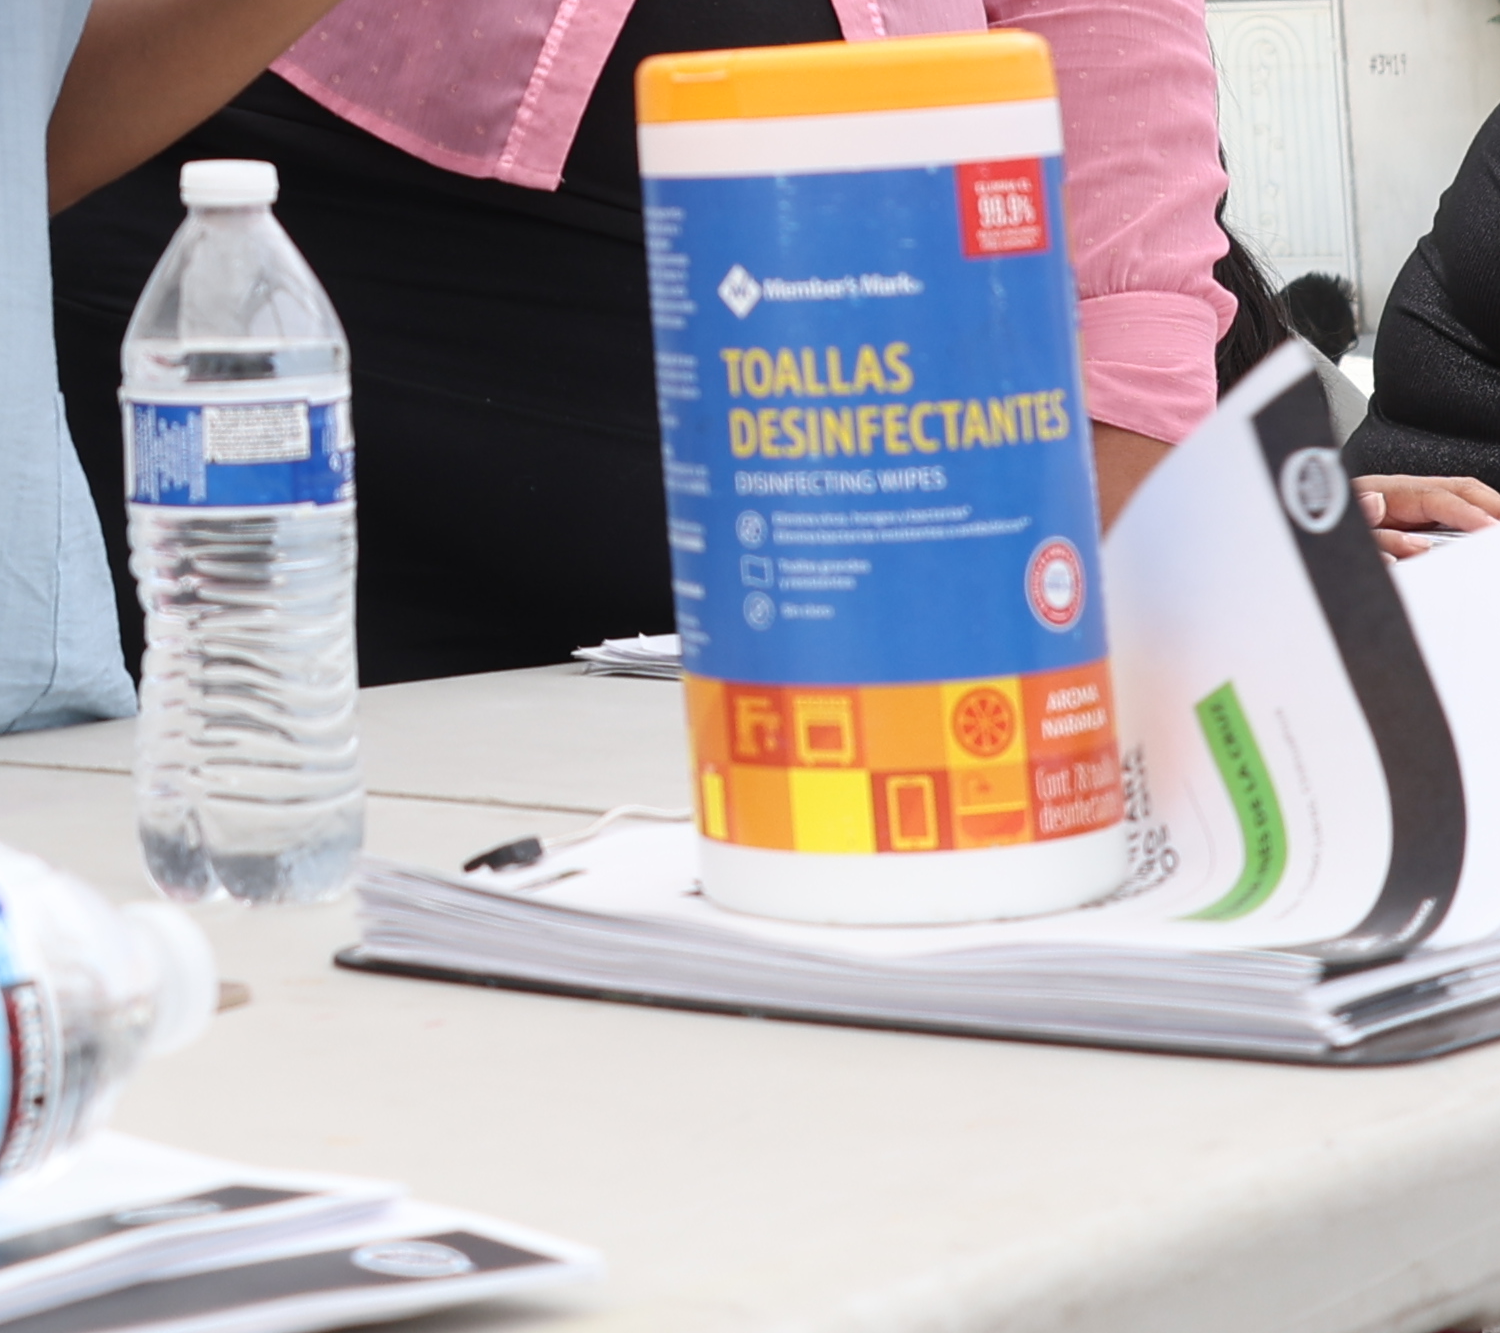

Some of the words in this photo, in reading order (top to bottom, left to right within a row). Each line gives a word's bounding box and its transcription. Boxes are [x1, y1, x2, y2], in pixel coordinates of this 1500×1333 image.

[719, 340, 915, 400] TOALLAS
[728, 387, 1071, 459] DESINFECTANTES
[735, 468, 874, 497] DISINFECTING
[877, 464, 948, 494] WIPES
